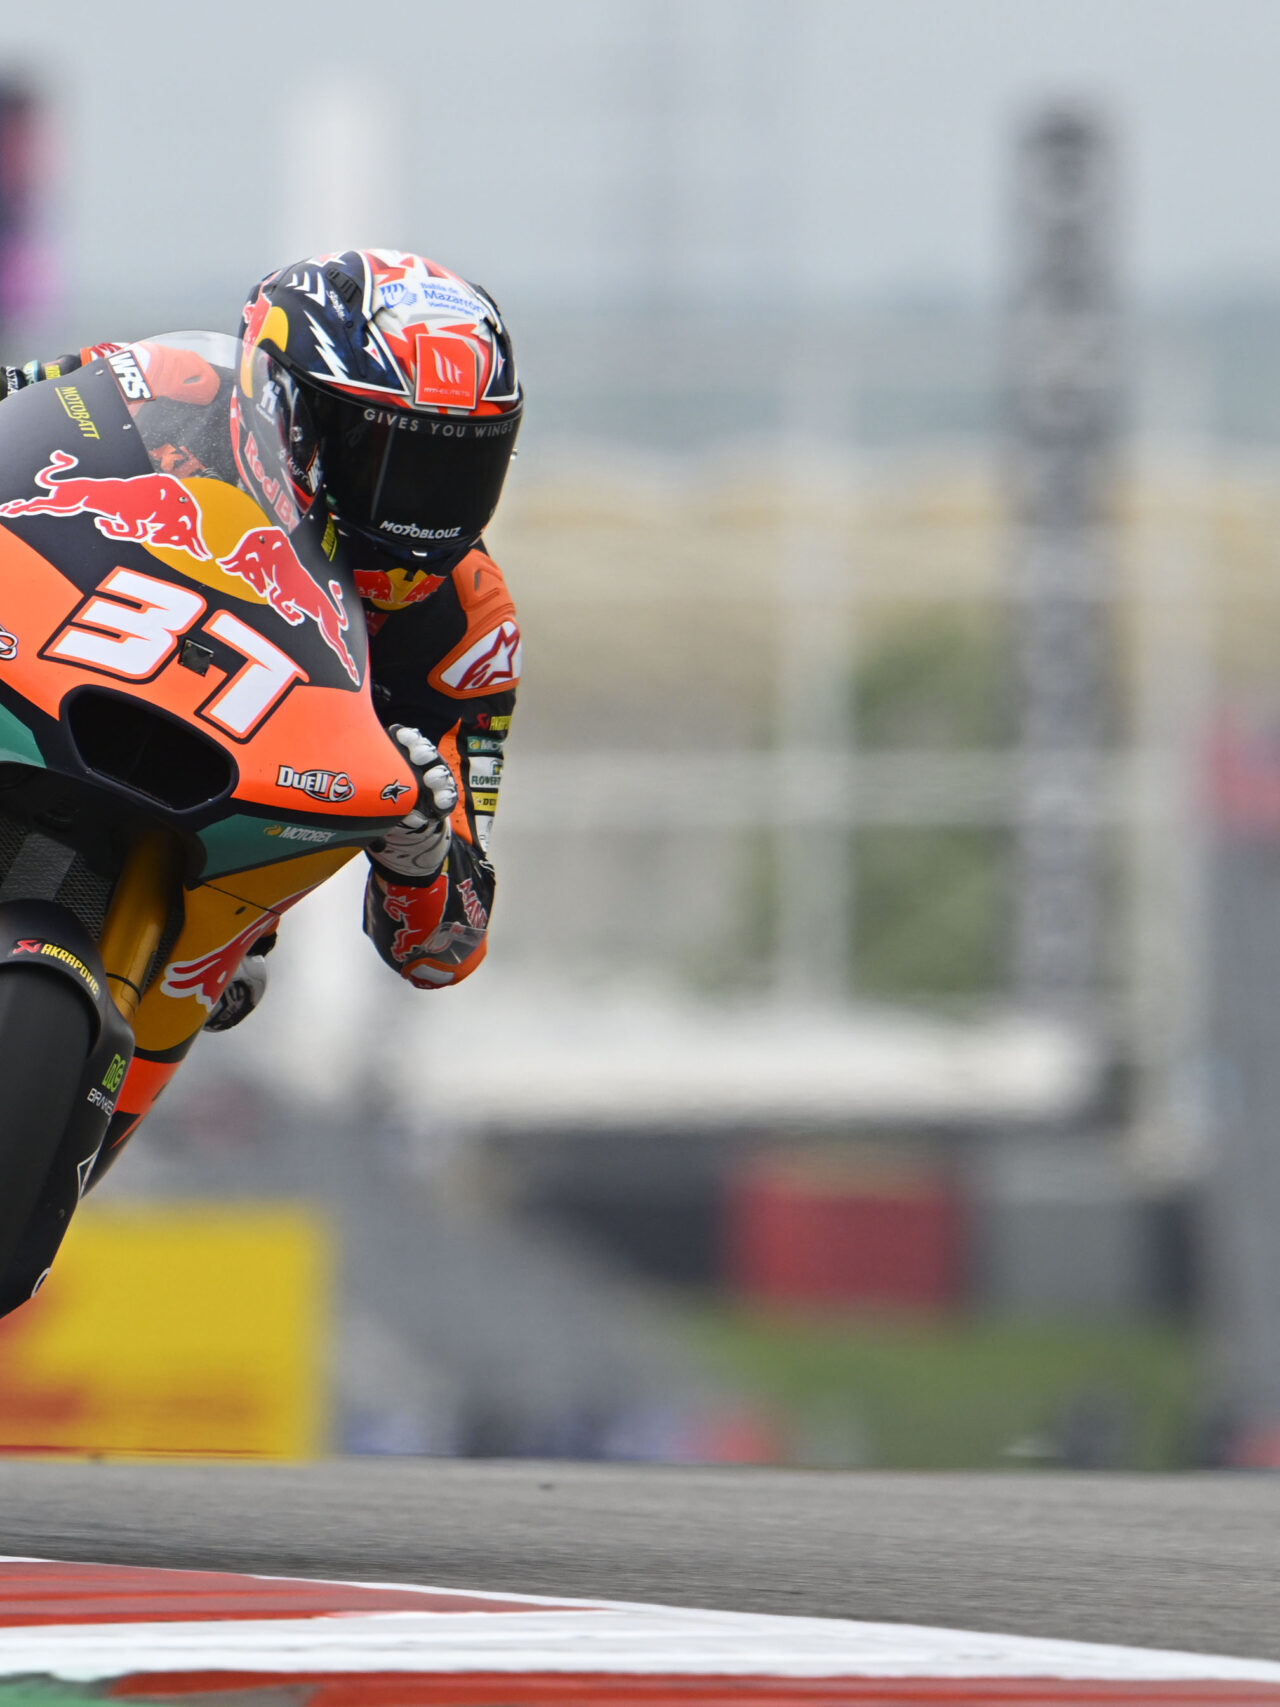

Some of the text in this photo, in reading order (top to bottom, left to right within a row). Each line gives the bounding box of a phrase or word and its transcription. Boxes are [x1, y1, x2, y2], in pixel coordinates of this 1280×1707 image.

[54, 386, 101, 440] MOTOBATT
[363, 409, 514, 438] GIVES YOU WINGS
[379, 520, 462, 539] MOTOBLOUZ
[48, 567, 302, 736] 37
[277, 826, 337, 843] MOTOREX
